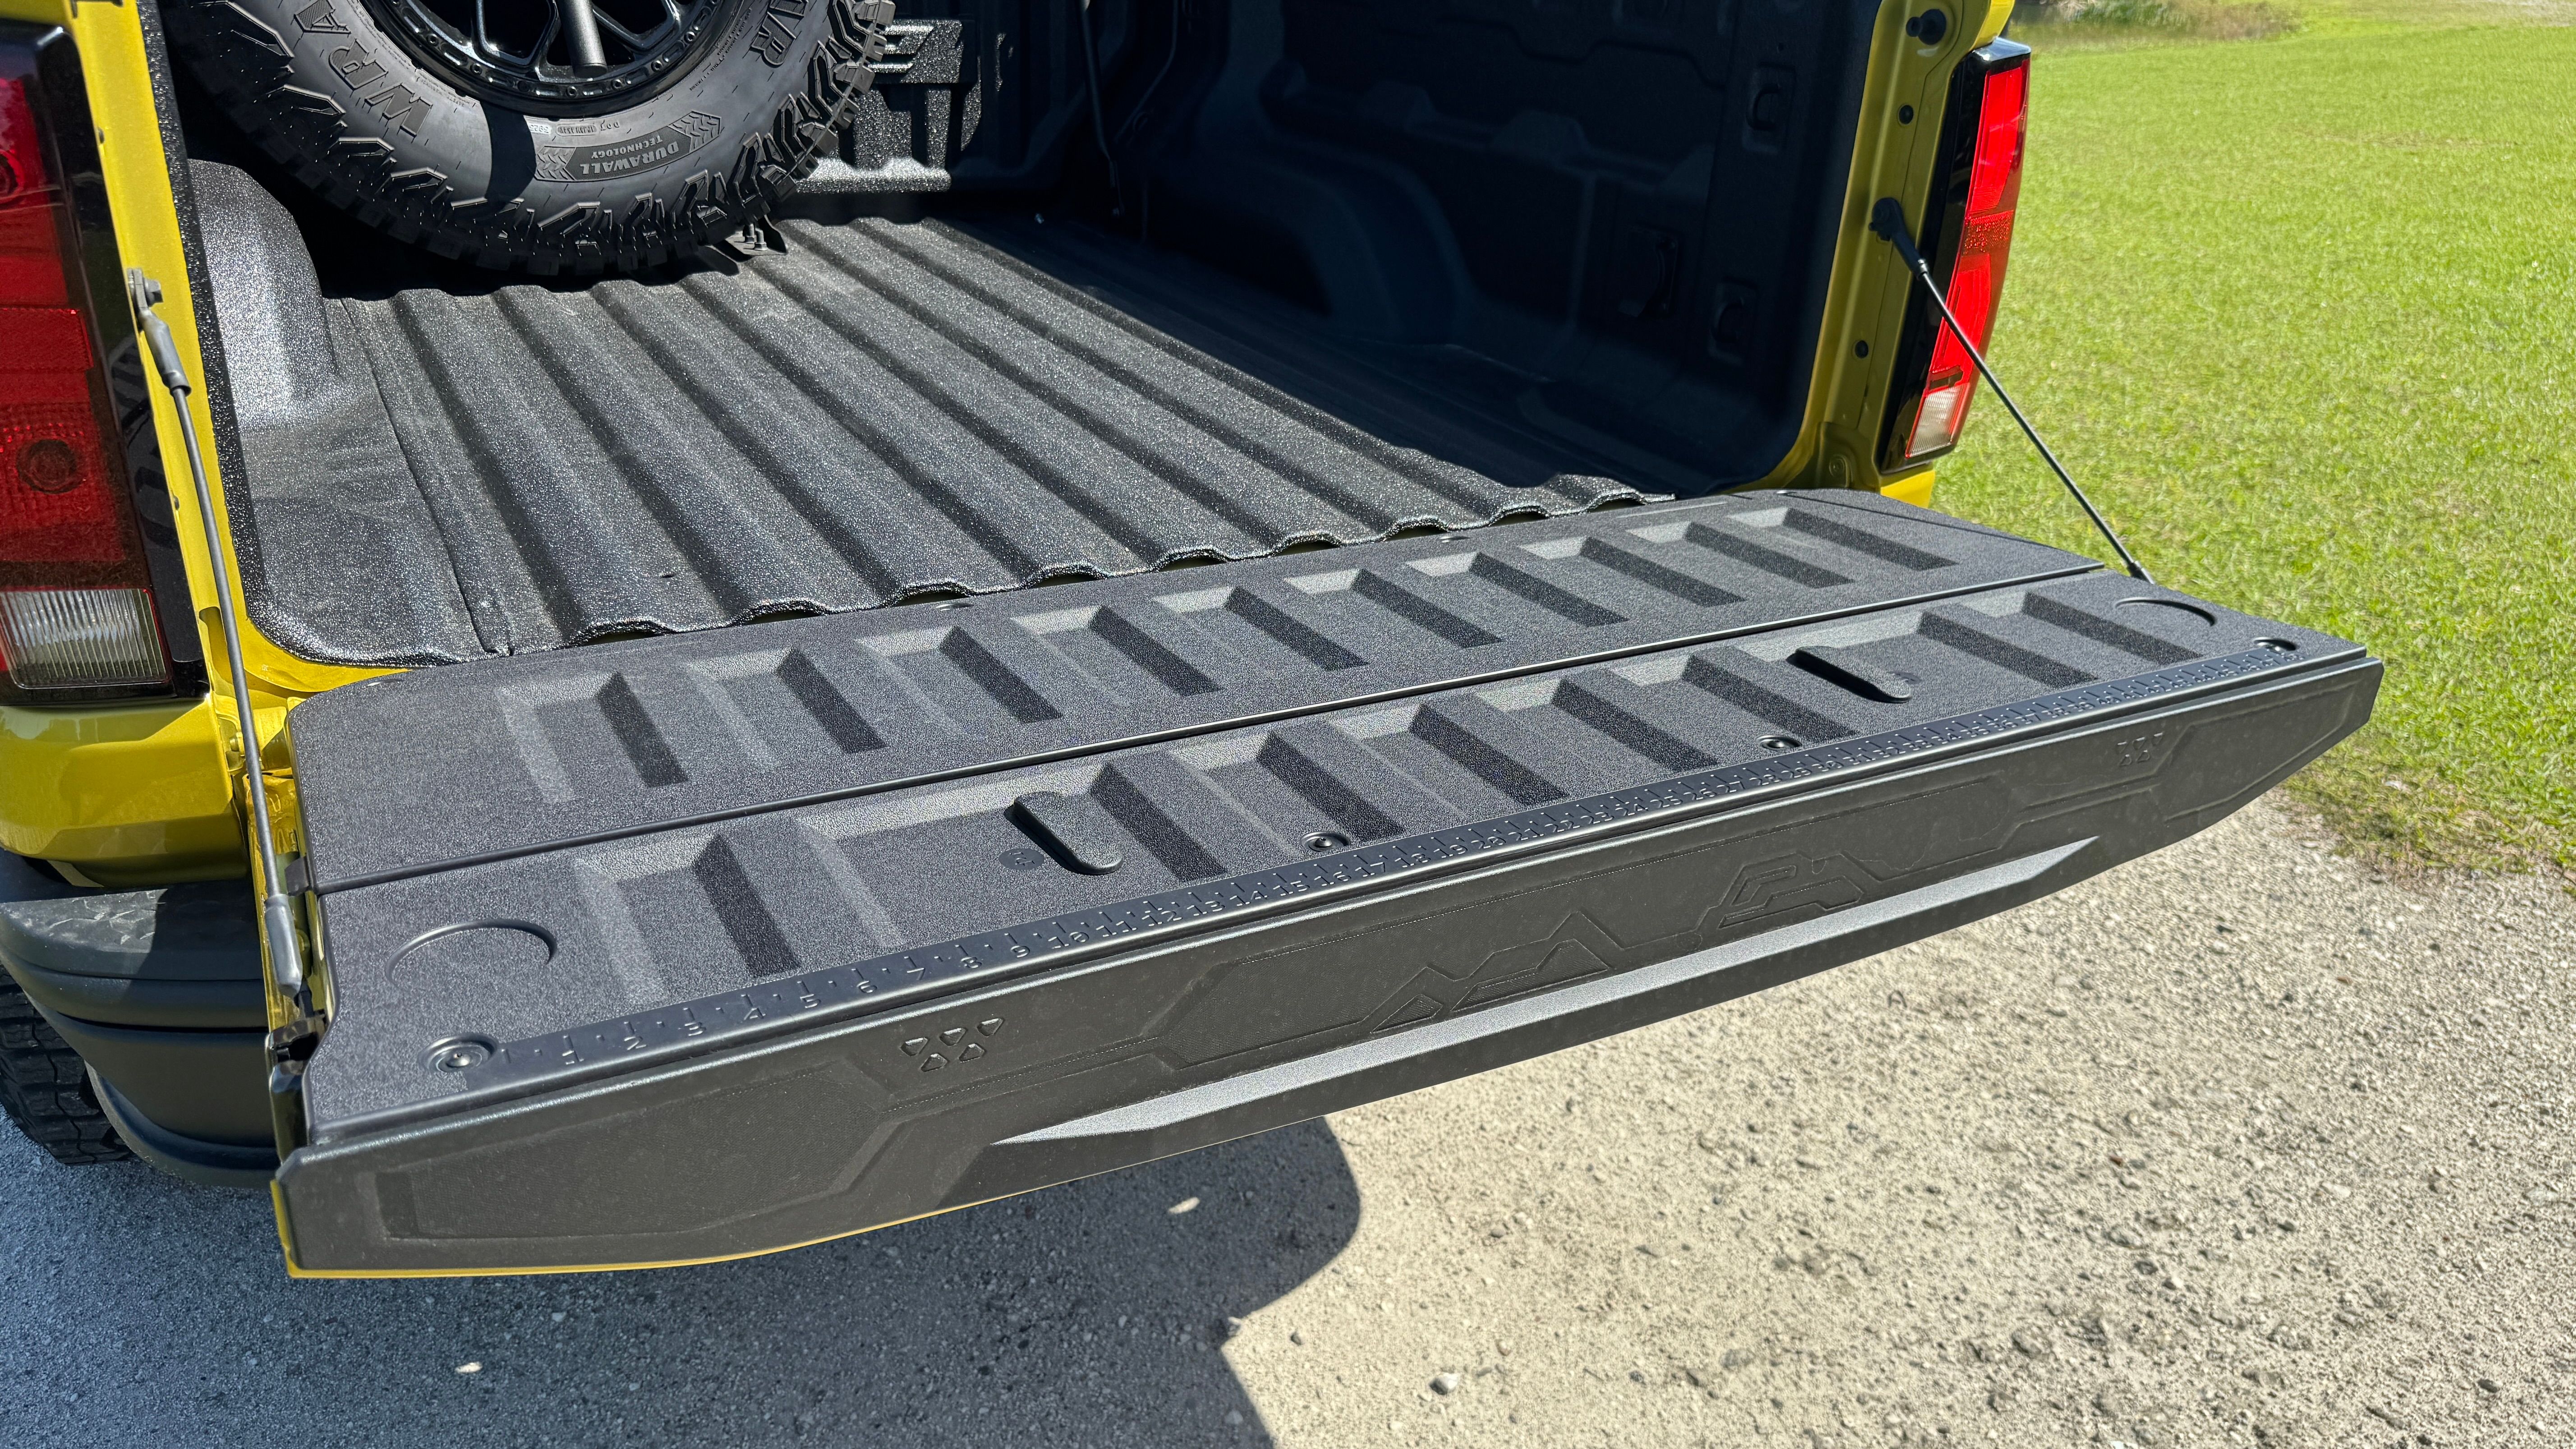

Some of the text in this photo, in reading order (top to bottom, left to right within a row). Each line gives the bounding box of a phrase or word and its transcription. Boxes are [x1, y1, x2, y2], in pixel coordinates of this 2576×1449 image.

[600, 121, 620, 131] DOT
[580, 141, 680, 175] DURAWALL
[591, 135, 663, 159] TECHNOLOGY
[562, 1050, 584, 1065] 1
[624, 1036, 647, 1050] 2
[685, 1022, 706, 1036] 3
[744, 1007, 765, 1020] 4
[800, 994, 821, 1008] 5
[857, 980, 877, 993] 6
[907, 967, 925, 981] 7
[961, 956, 982, 969] 8
[1011, 945, 1030, 958] 9
[1048, 932, 1089, 948] 10
[1096, 920, 1137, 937] 11
[1142, 910, 1182, 926] 12
[1187, 901, 1226, 916] 13
[1230, 890, 1268, 906] 14
[1273, 880, 1310, 896] 15
[1314, 871, 1352, 886] 16
[1355, 862, 1385, 877] 17
[1394, 853, 1431, 868] 18
[1433, 844, 1468, 858] 19
[1471, 836, 1506, 849] 20
[1508, 828, 1544, 841] 21
[1545, 819, 1580, 833] 22
[1580, 812, 1615, 824] 23
[1615, 804, 1648, 816] 24
[1650, 796, 1683, 808] 25
[1684, 788, 1716, 800] 26
[1716, 781, 1745, 793] 27
[1749, 774, 1782, 785] 28
[1781, 768, 1812, 778] 29
[1812, 760, 1844, 771] 30
[1843, 754, 1876, 765] 31
[1872, 746, 1906, 758] 32
[1903, 740, 1934, 751] 33
[1931, 733, 1961, 744] 34
[1960, 726, 1990, 737] 35
[1987, 720, 2017, 731] 36
[2015, 713, 2041, 724] 37
[2041, 707, 2070, 718] 38
[2067, 701, 2095, 712] 39
[2097, 696, 2121, 704] 40
[2121, 690, 2147, 699] 41
